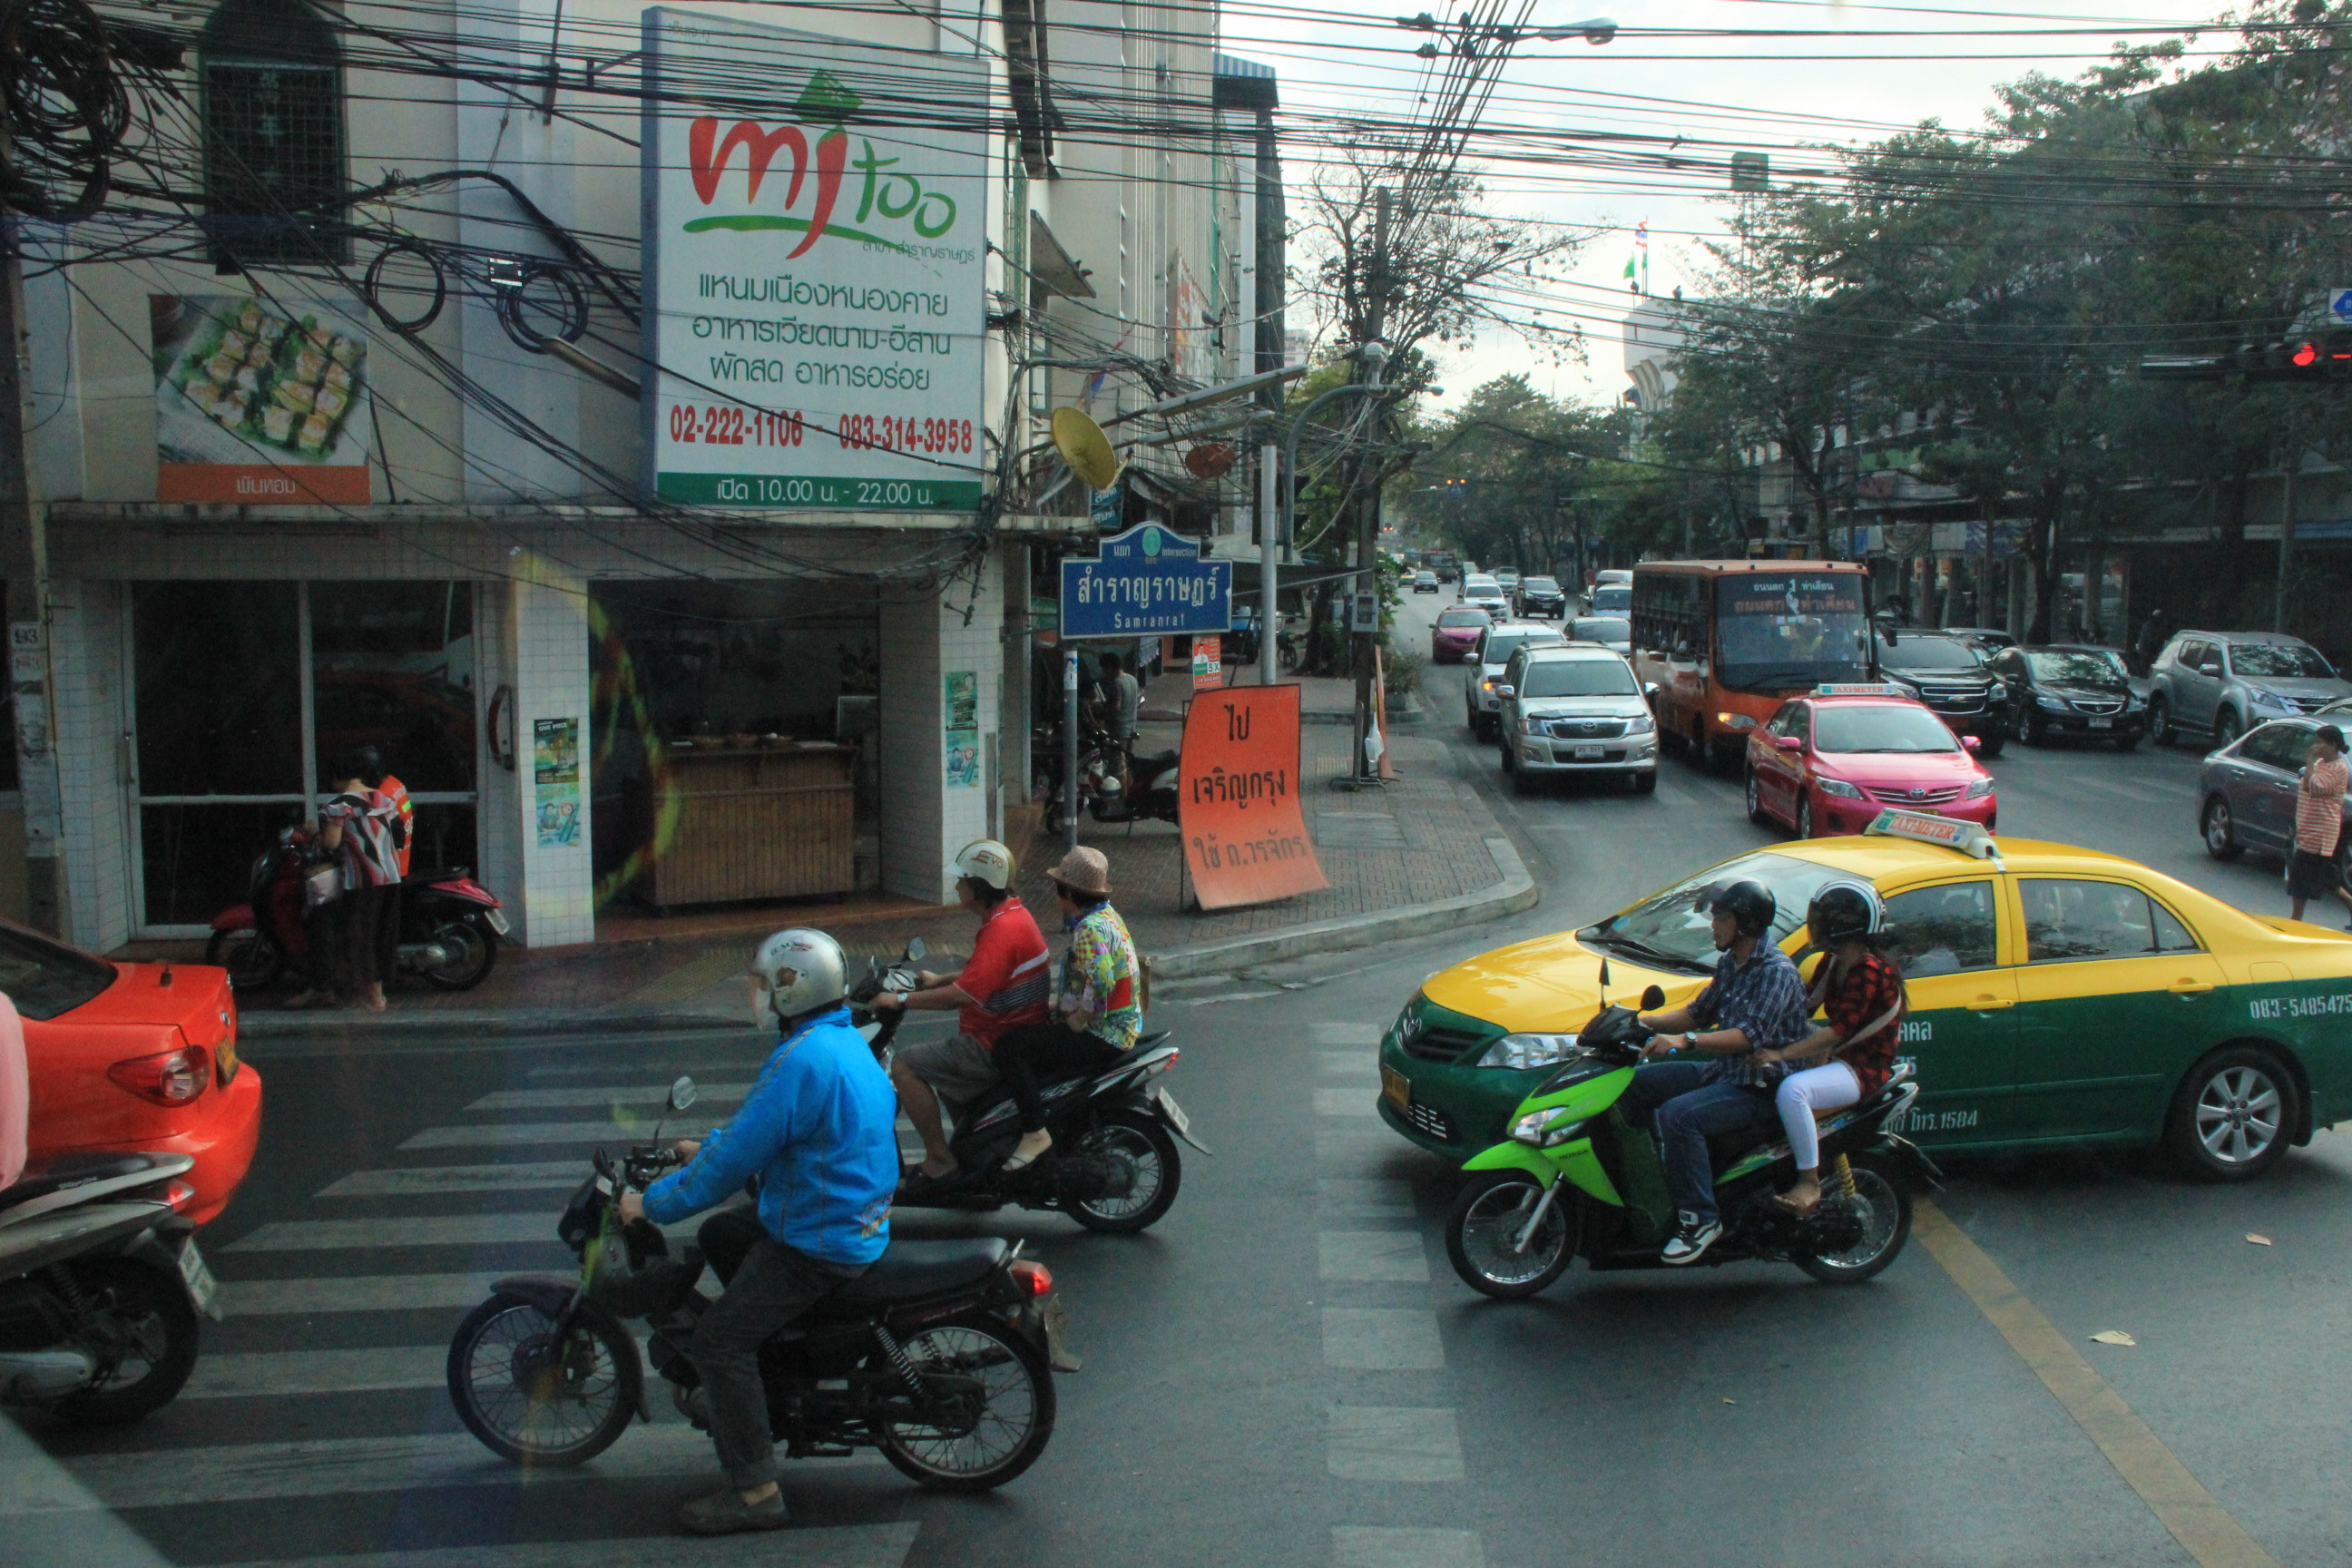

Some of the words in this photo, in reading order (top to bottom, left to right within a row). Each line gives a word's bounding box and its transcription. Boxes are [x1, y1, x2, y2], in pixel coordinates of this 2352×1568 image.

[699, 273, 949, 317] แหนมเนืองหนองคาย
[691, 315, 951, 356] อาหารเวียดนาม-อีสาน
[710, 350, 784, 384] ผักสด
[795, 360, 931, 391] อาหารอร่อย
[670, 404, 804, 447] 02-222-1106
[838, 413, 973, 455] 083-314-3958
[717, 478, 750, 501] เปิด
[758, 479, 814, 503] 10.00
[821, 486, 838, 503] น.
[858, 483, 912, 505] 22.00
[916, 488, 935, 505] น.
[1113, 544, 1132, 557] แยก
[1161, 547, 1197, 558] Intersection
[1078, 565, 1220, 609] สำราญราษฎร์
[1114, 612, 1185, 630] Samranrat
[1223, 704, 1250, 741] ไป
[1193, 767, 1286, 809] เจริญกรุง
[1192, 832, 1221, 870] ใช้
